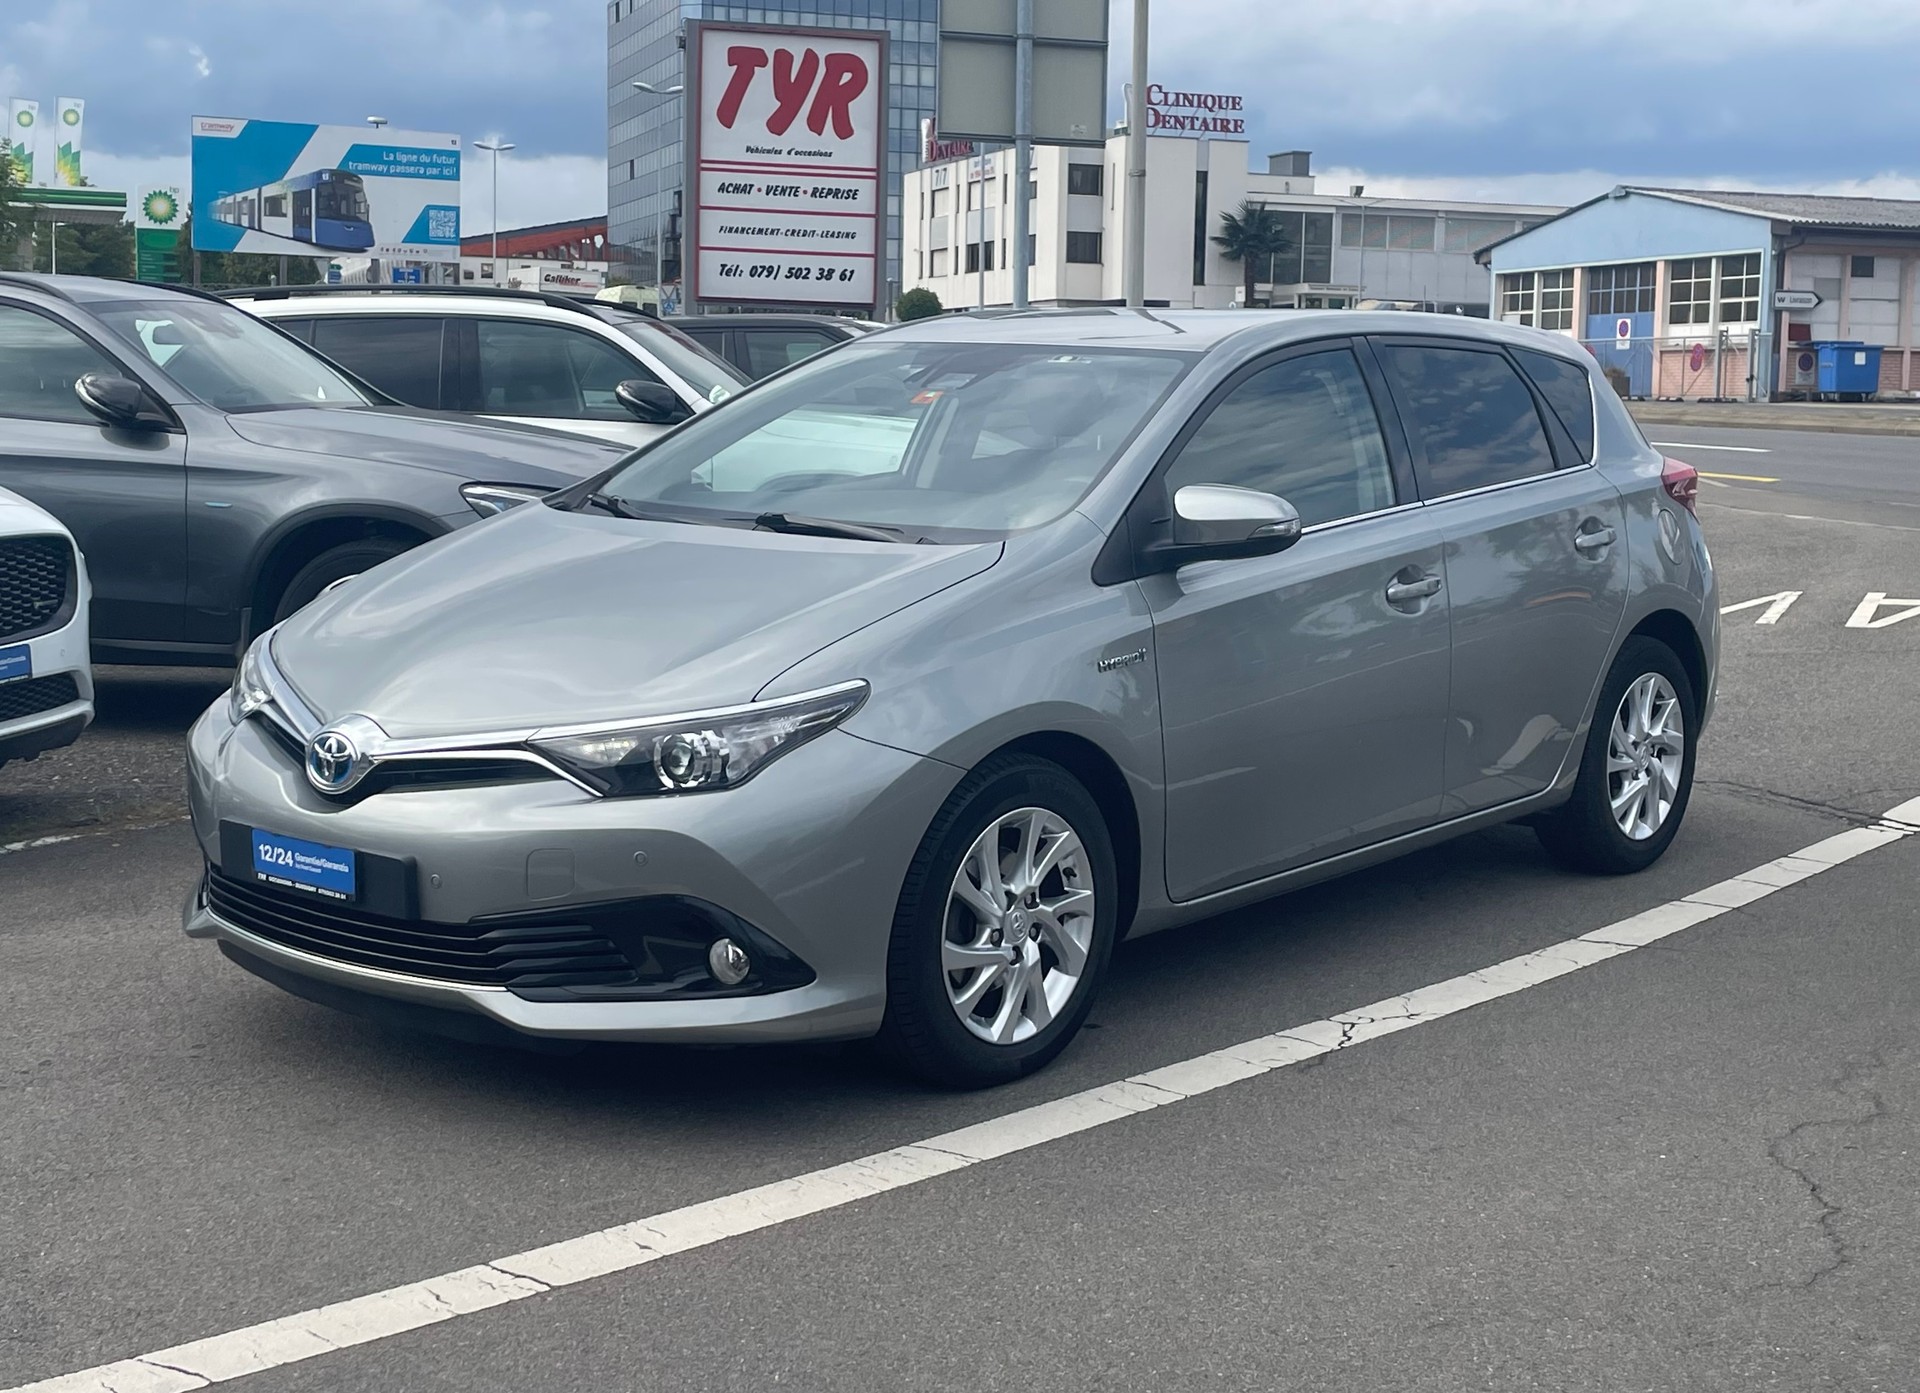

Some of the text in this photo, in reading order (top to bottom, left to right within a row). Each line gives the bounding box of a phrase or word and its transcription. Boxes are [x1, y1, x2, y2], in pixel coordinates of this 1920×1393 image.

[716, 45, 869, 141] TYR
[1146, 83, 1243, 112] CLINIQUE
[1146, 106, 1245, 134] DENTAIRE
[383, 151, 456, 165] La ligne du futur
[745, 145, 833, 158] Véhicules d'occasions
[348, 161, 388, 173] tramway
[390, 164, 424, 174] passera
[426, 166, 440, 176] par
[717, 181, 860, 201] ACHAT VENTE REPRISE
[544, 273, 582, 286] Galliker
[719, 263, 744, 278] Tél:
[784, 266, 812, 281] 502
[815, 267, 835, 281] 38
[838, 269, 855, 283] 61
[1097, 647, 1147, 673] HYBRID
[258, 843, 294, 868] 12/24
